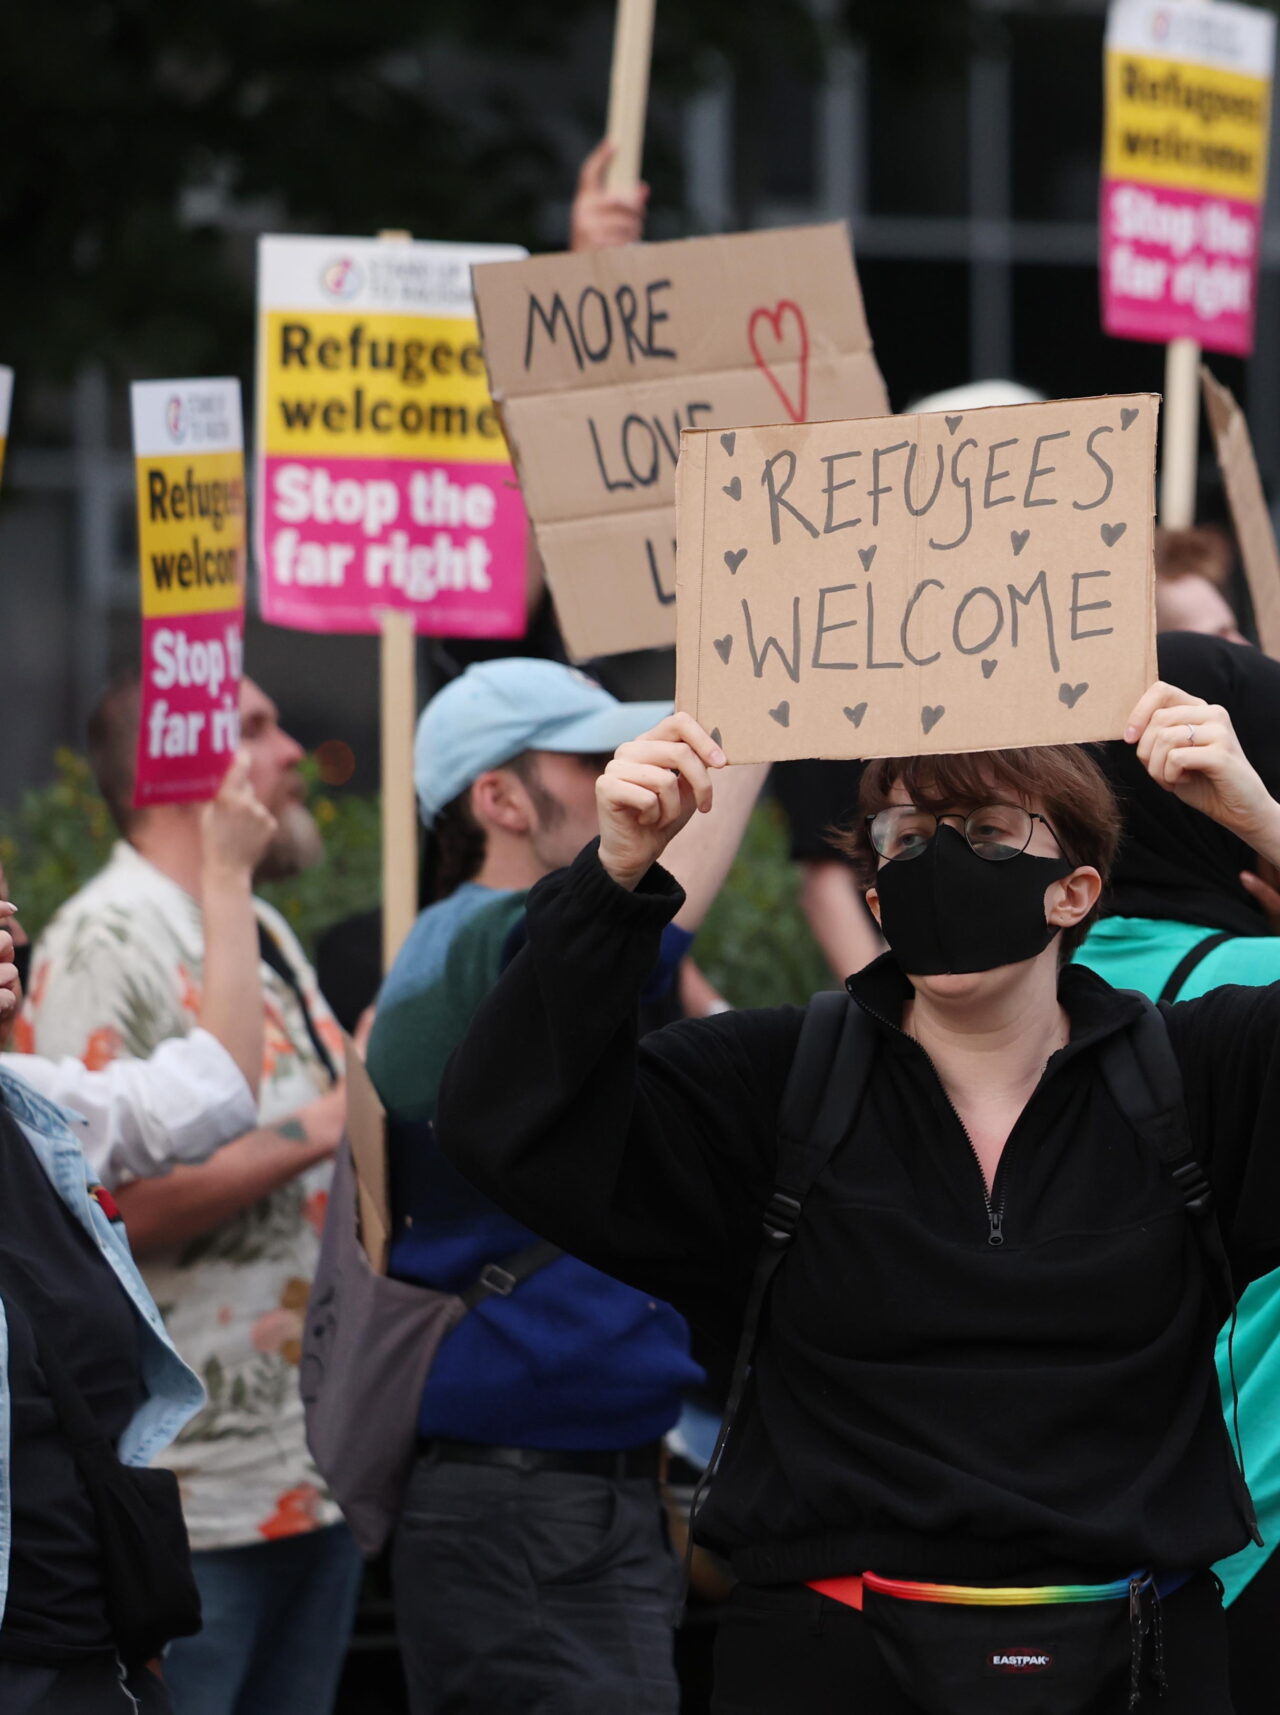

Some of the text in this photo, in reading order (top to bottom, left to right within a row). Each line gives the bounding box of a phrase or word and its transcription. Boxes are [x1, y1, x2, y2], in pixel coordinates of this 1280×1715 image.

[524, 278, 677, 373] MORE
[273, 463, 496, 537] Stop the
[761, 425, 1115, 551] REFUGEES
[272, 527, 493, 602] far right
[152, 627, 226, 699] Stop
[741, 569, 1114, 684] WELCOME
[147, 699, 206, 760] far
